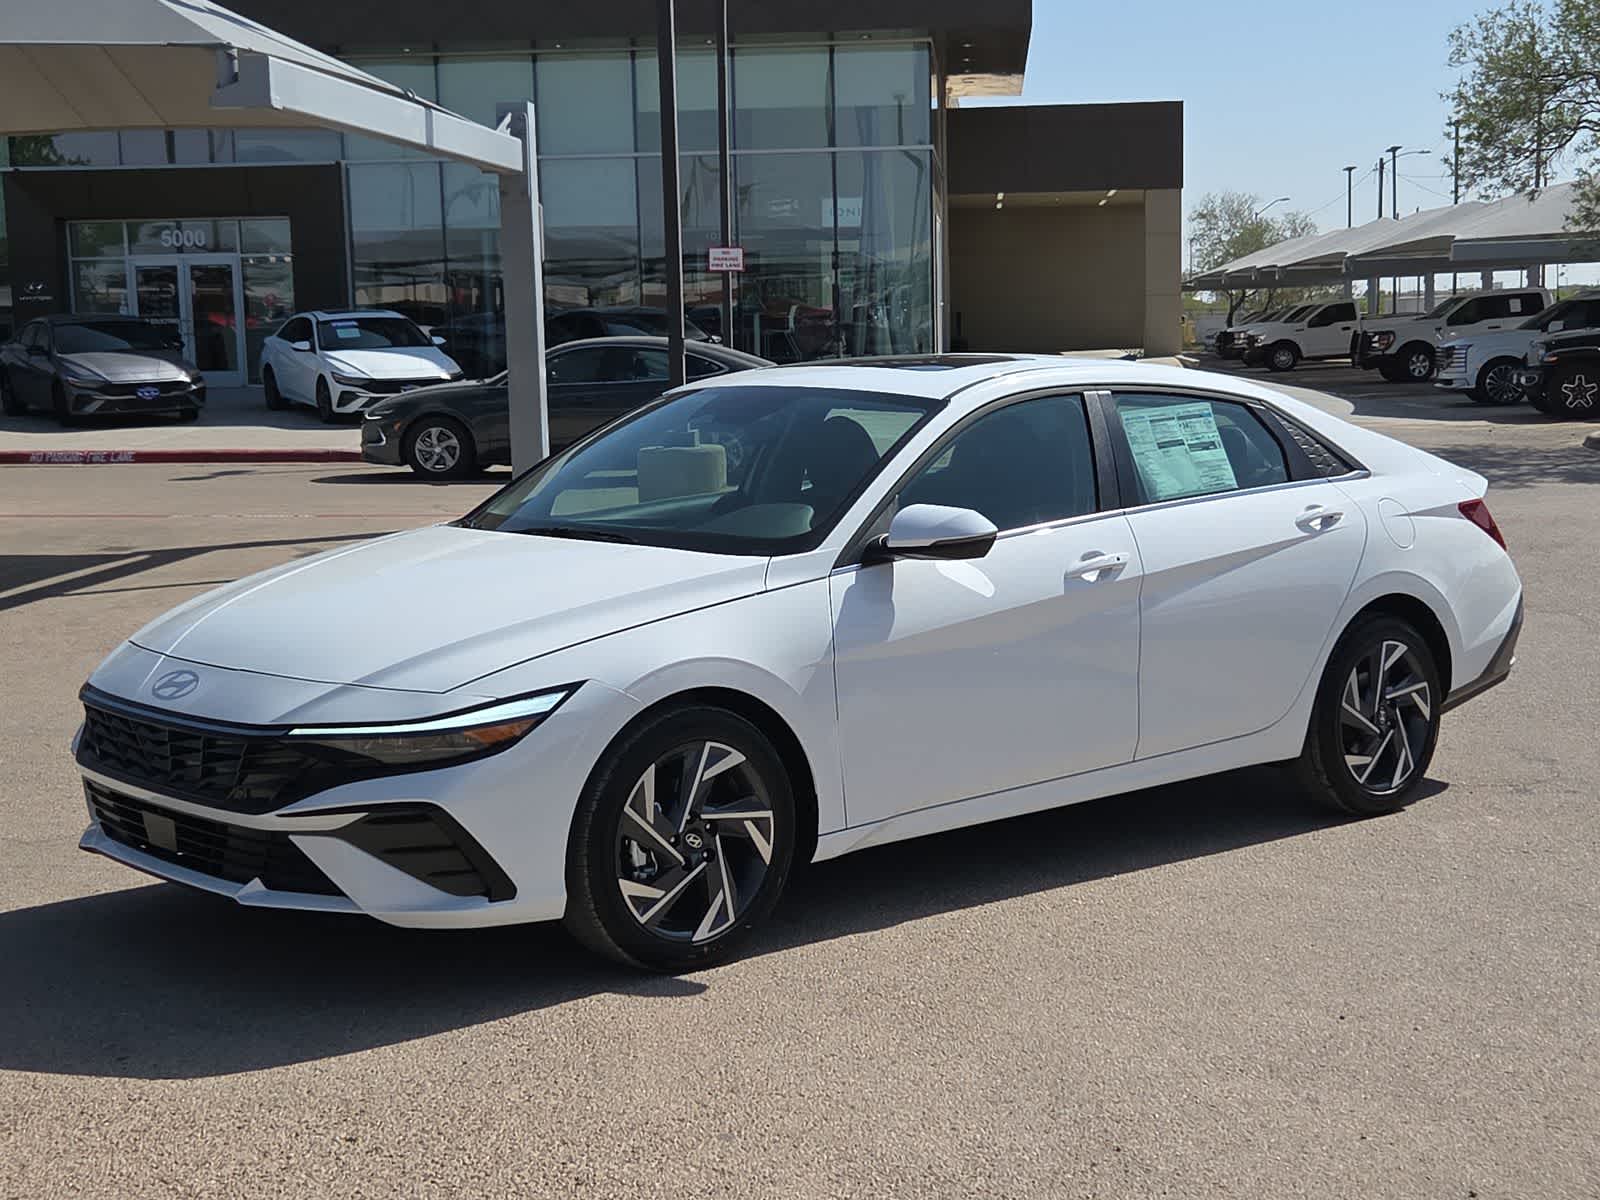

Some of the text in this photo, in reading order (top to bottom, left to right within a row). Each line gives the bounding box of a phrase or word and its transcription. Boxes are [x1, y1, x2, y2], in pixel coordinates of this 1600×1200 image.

[161, 230, 206, 247] 5000
[30, 451, 136, 462] NO PARKING FIRE LANE
